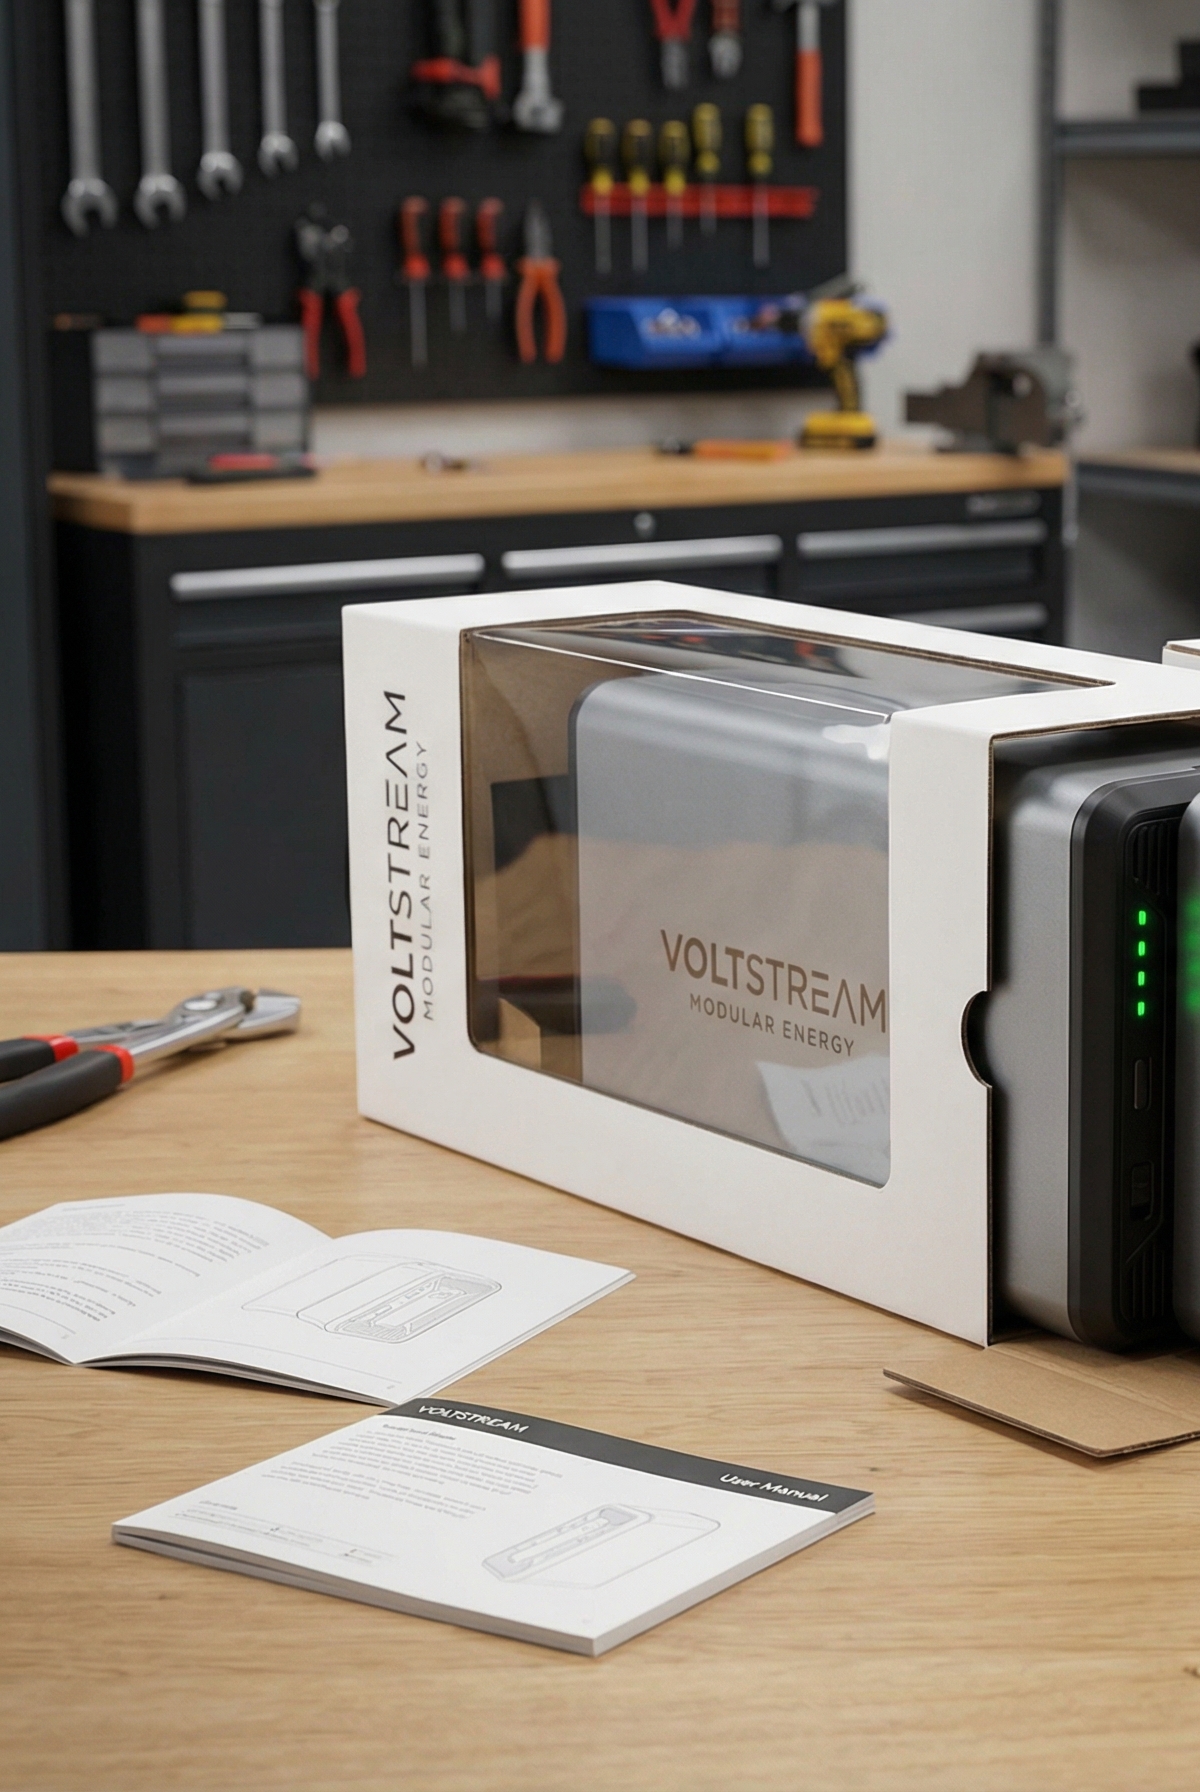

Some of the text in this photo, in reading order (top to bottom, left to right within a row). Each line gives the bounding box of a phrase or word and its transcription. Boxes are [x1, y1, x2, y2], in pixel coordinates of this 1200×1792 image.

[383, 690, 416, 1060] VOLTSTREAM
[416, 741, 435, 1022] MODULAR ENERGY
[660, 929, 887, 1034] VOLTSTREAM
[689, 993, 855, 1057] MODULAR ENERGY
[418, 1405, 530, 1433] VOLTSTREAM
[720, 1473, 829, 1502] User Manual
